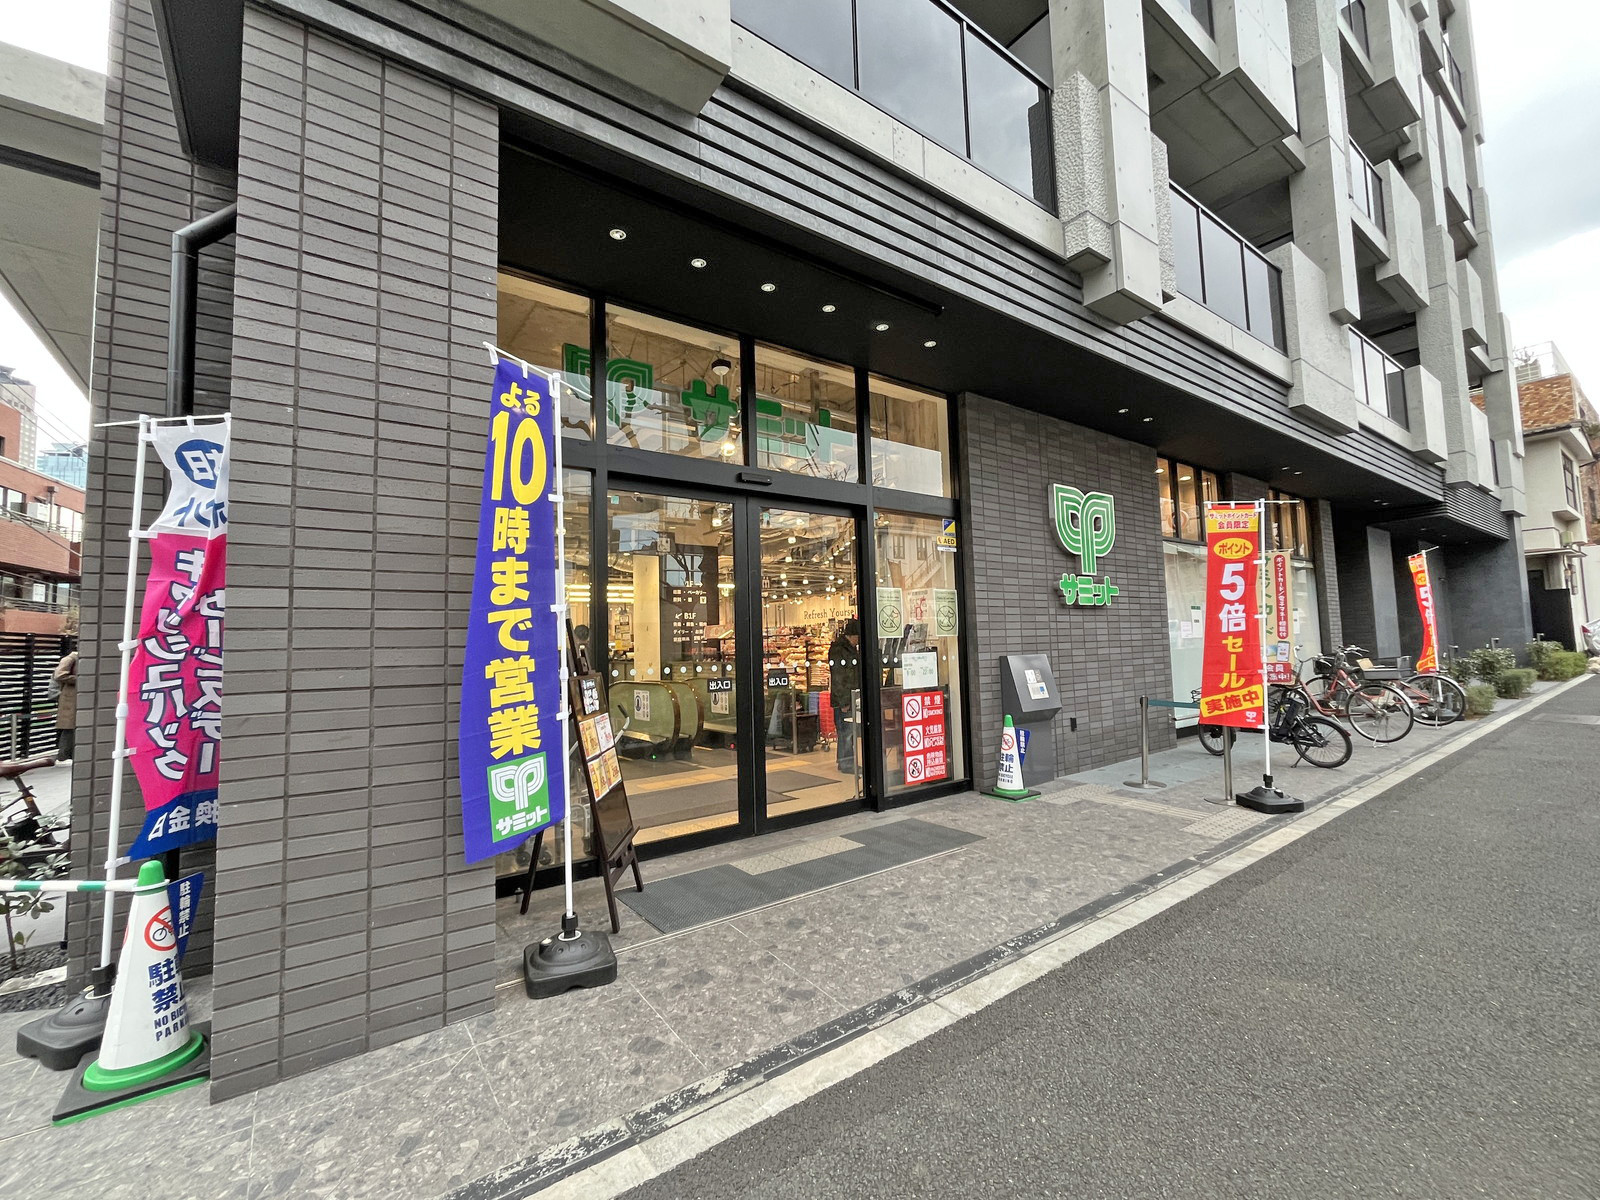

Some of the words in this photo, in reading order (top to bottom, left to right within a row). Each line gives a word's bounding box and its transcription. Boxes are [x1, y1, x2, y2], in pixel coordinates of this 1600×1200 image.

[500, 381, 541, 417] よる
[491, 411, 547, 505] 10
[1218, 520, 1249, 529] 会員限定
[1218, 542, 1250, 555] ポイント
[1059, 573, 1120, 606] サミット
[709, 680, 731, 690] 出入口
[769, 677, 788, 686] 出入口
[1205, 690, 1260, 714] 実施中
[495, 804, 548, 837] サミット
[148, 957, 181, 988] 駐
[154, 1015, 169, 1029] NO
